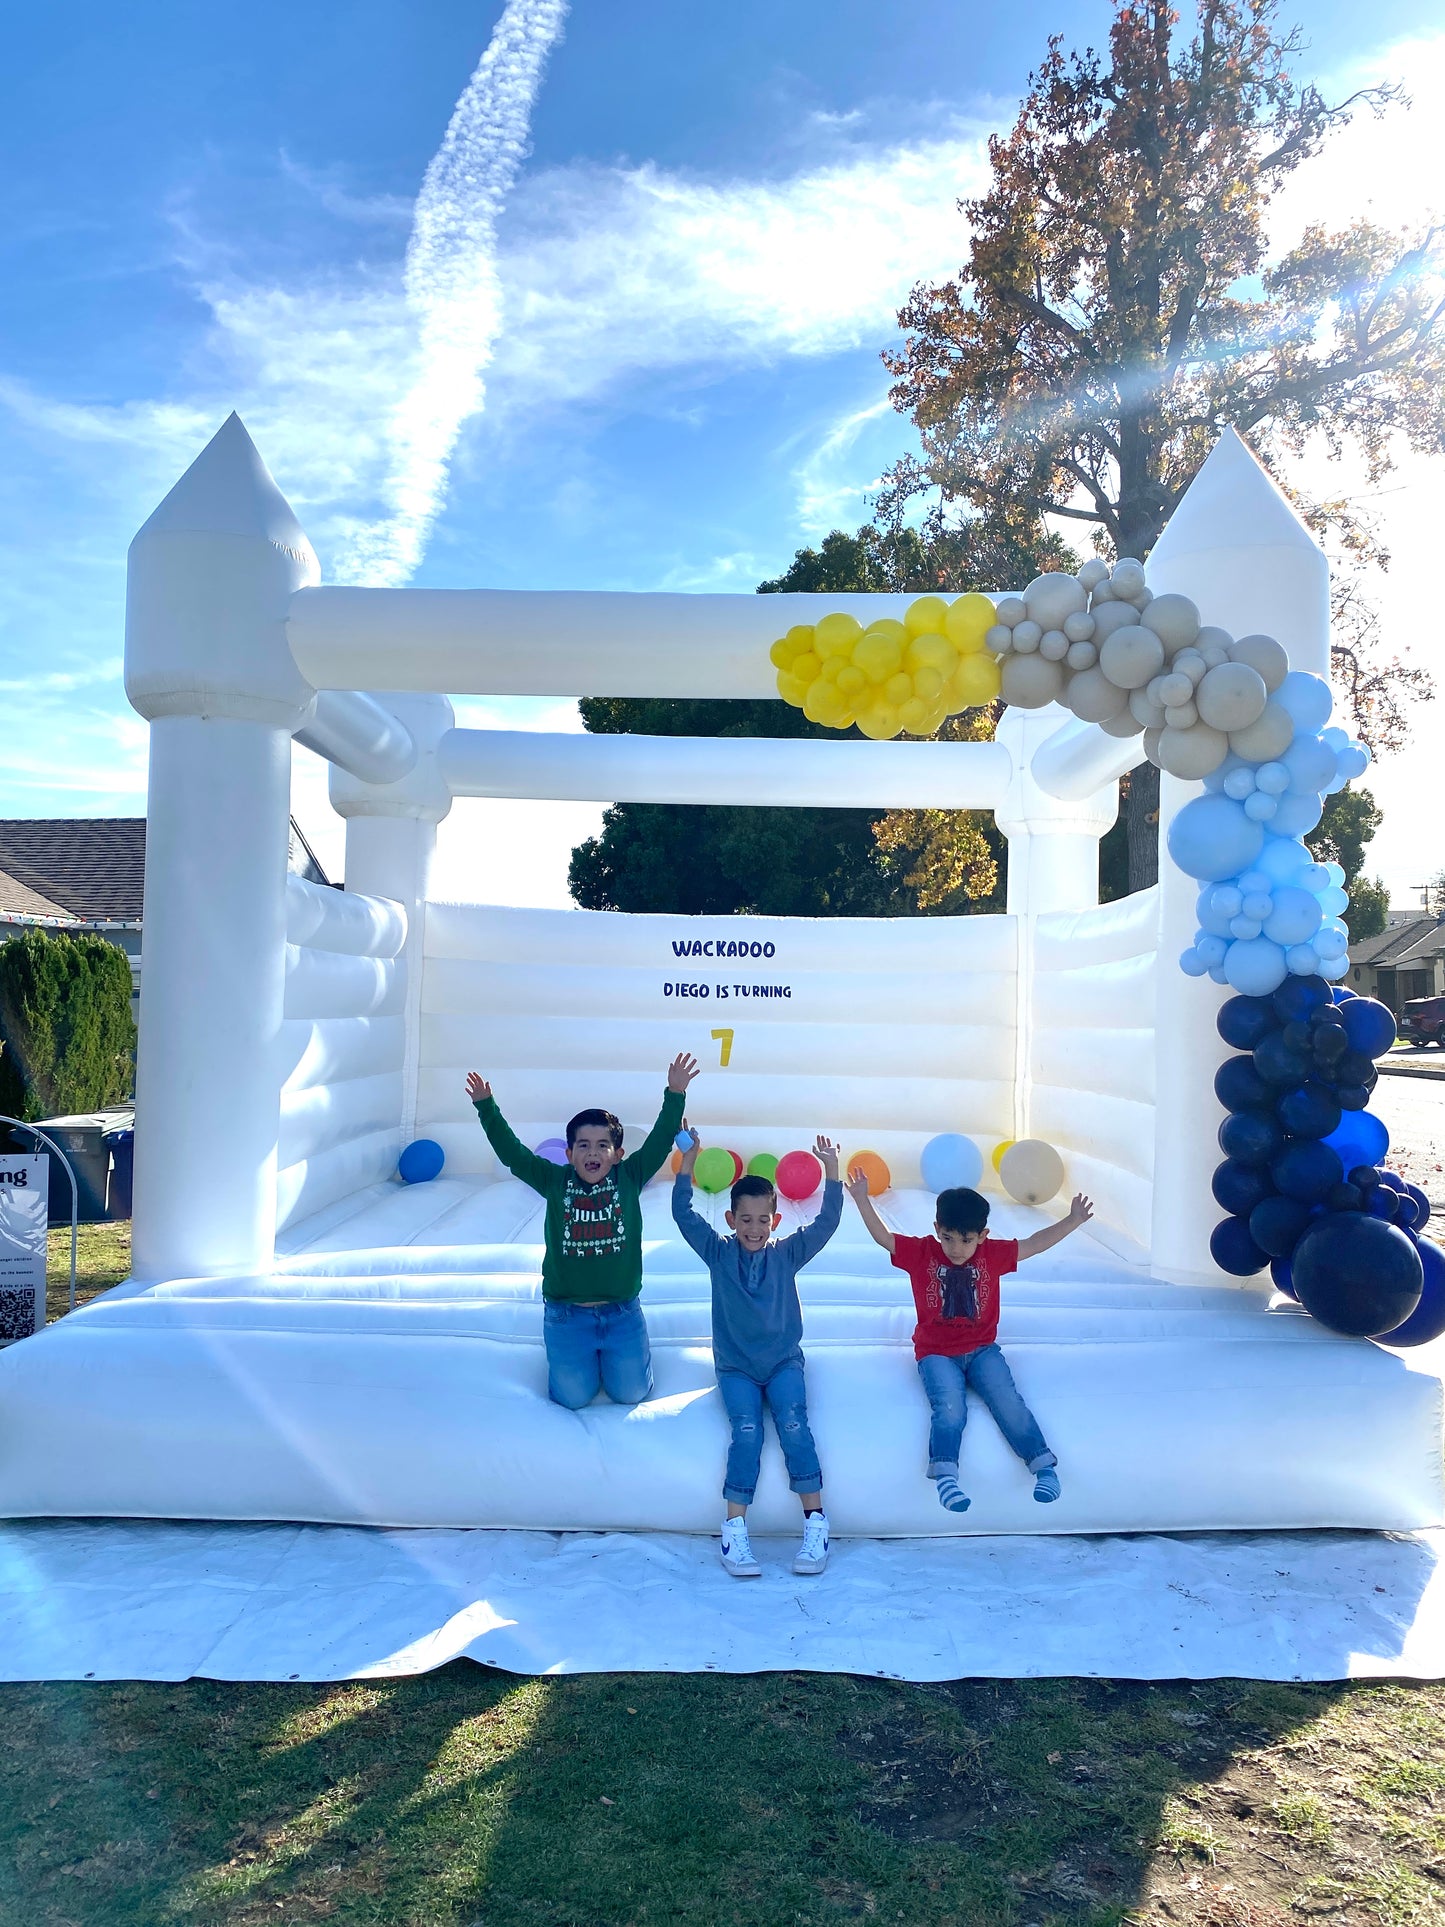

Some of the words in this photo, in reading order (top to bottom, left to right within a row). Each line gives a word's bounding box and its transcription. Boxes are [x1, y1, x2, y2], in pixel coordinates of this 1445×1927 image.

[671, 940, 776, 958] WACKADOO
[663, 982, 710, 998] DIEGO
[716, 984, 729, 998] IS
[733, 984, 792, 998] TURNING
[711, 1028, 734, 1067] 7
